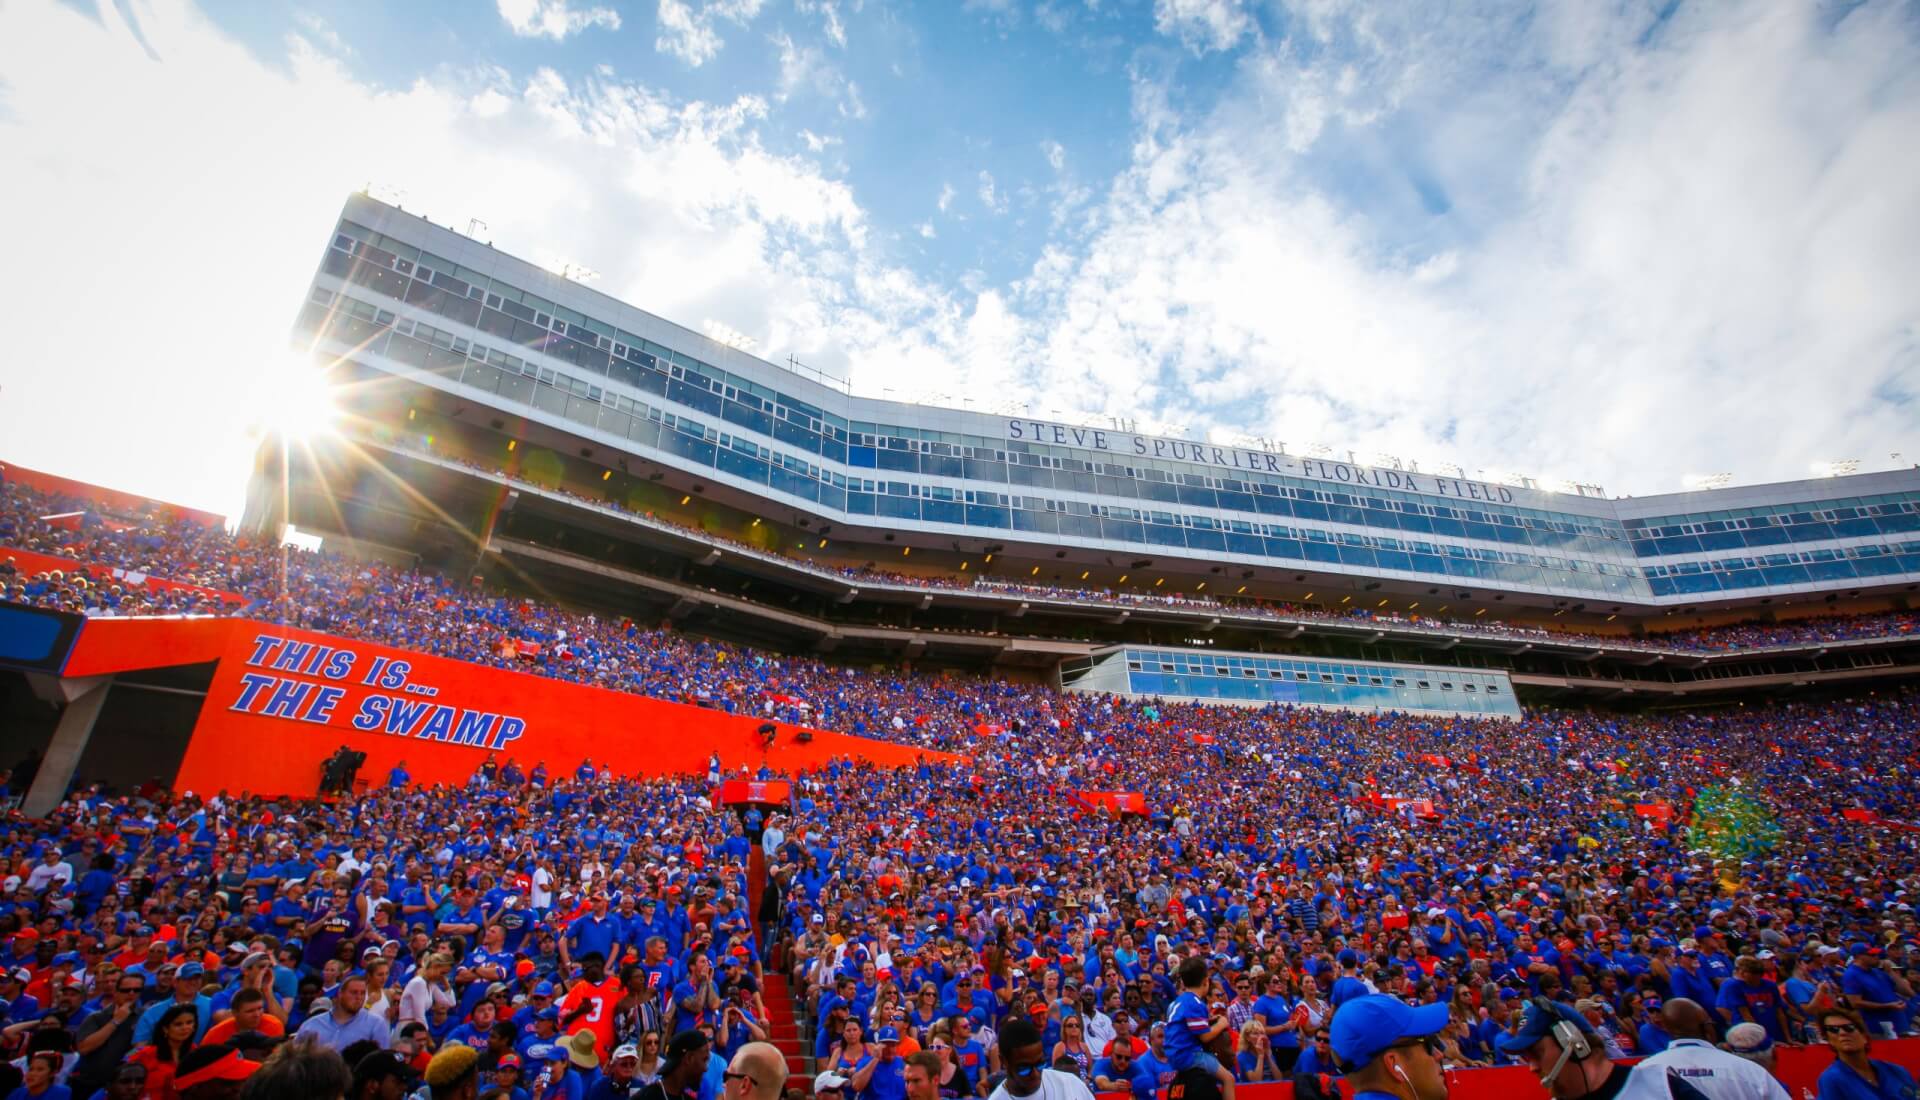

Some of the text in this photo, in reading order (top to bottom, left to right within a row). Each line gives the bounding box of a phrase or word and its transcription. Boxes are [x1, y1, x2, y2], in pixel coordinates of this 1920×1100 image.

[1009, 420, 1108, 450] STEVE
[1436, 478, 1513, 504] FIELD
[245, 634, 439, 697] THIS IS...
[228, 673, 527, 751] THE SWAMP
[1198, 899, 1207, 912] 1
[586, 996, 603, 1022] 3
[1678, 1068, 1714, 1077] FLORIDA
